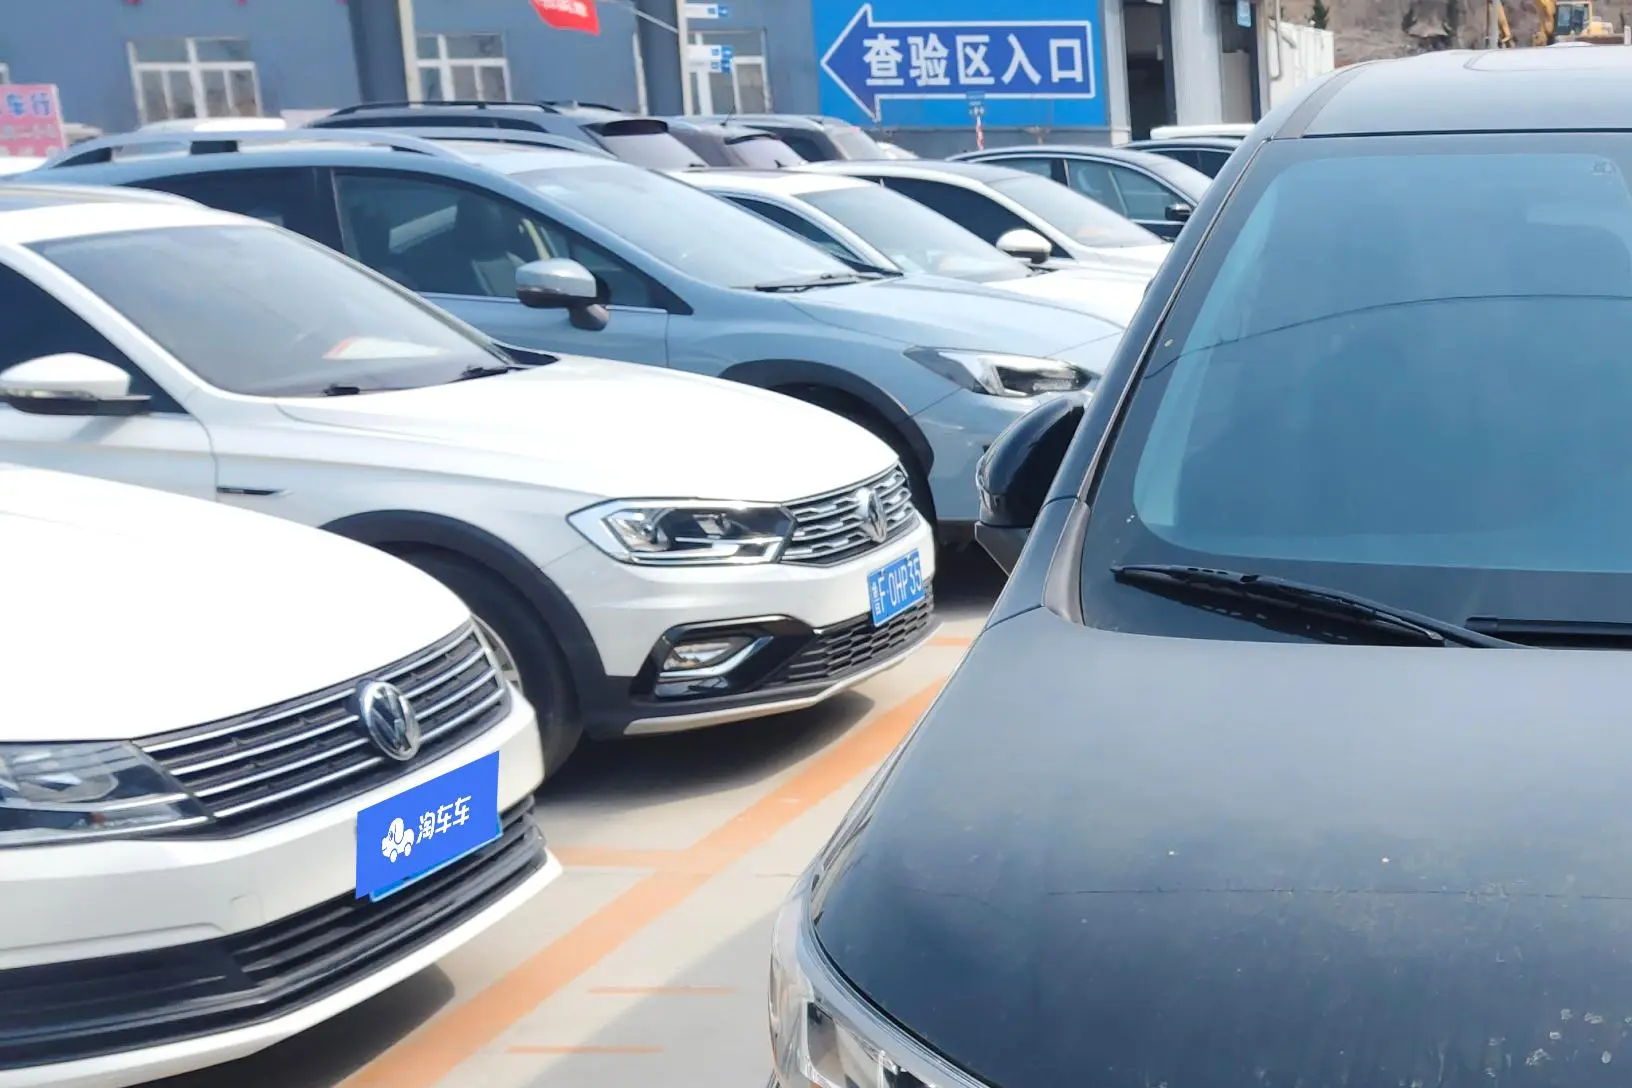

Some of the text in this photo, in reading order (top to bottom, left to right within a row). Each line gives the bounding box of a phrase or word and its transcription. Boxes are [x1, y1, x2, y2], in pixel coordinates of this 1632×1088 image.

[863, 33, 1084, 87] 查验区入口
